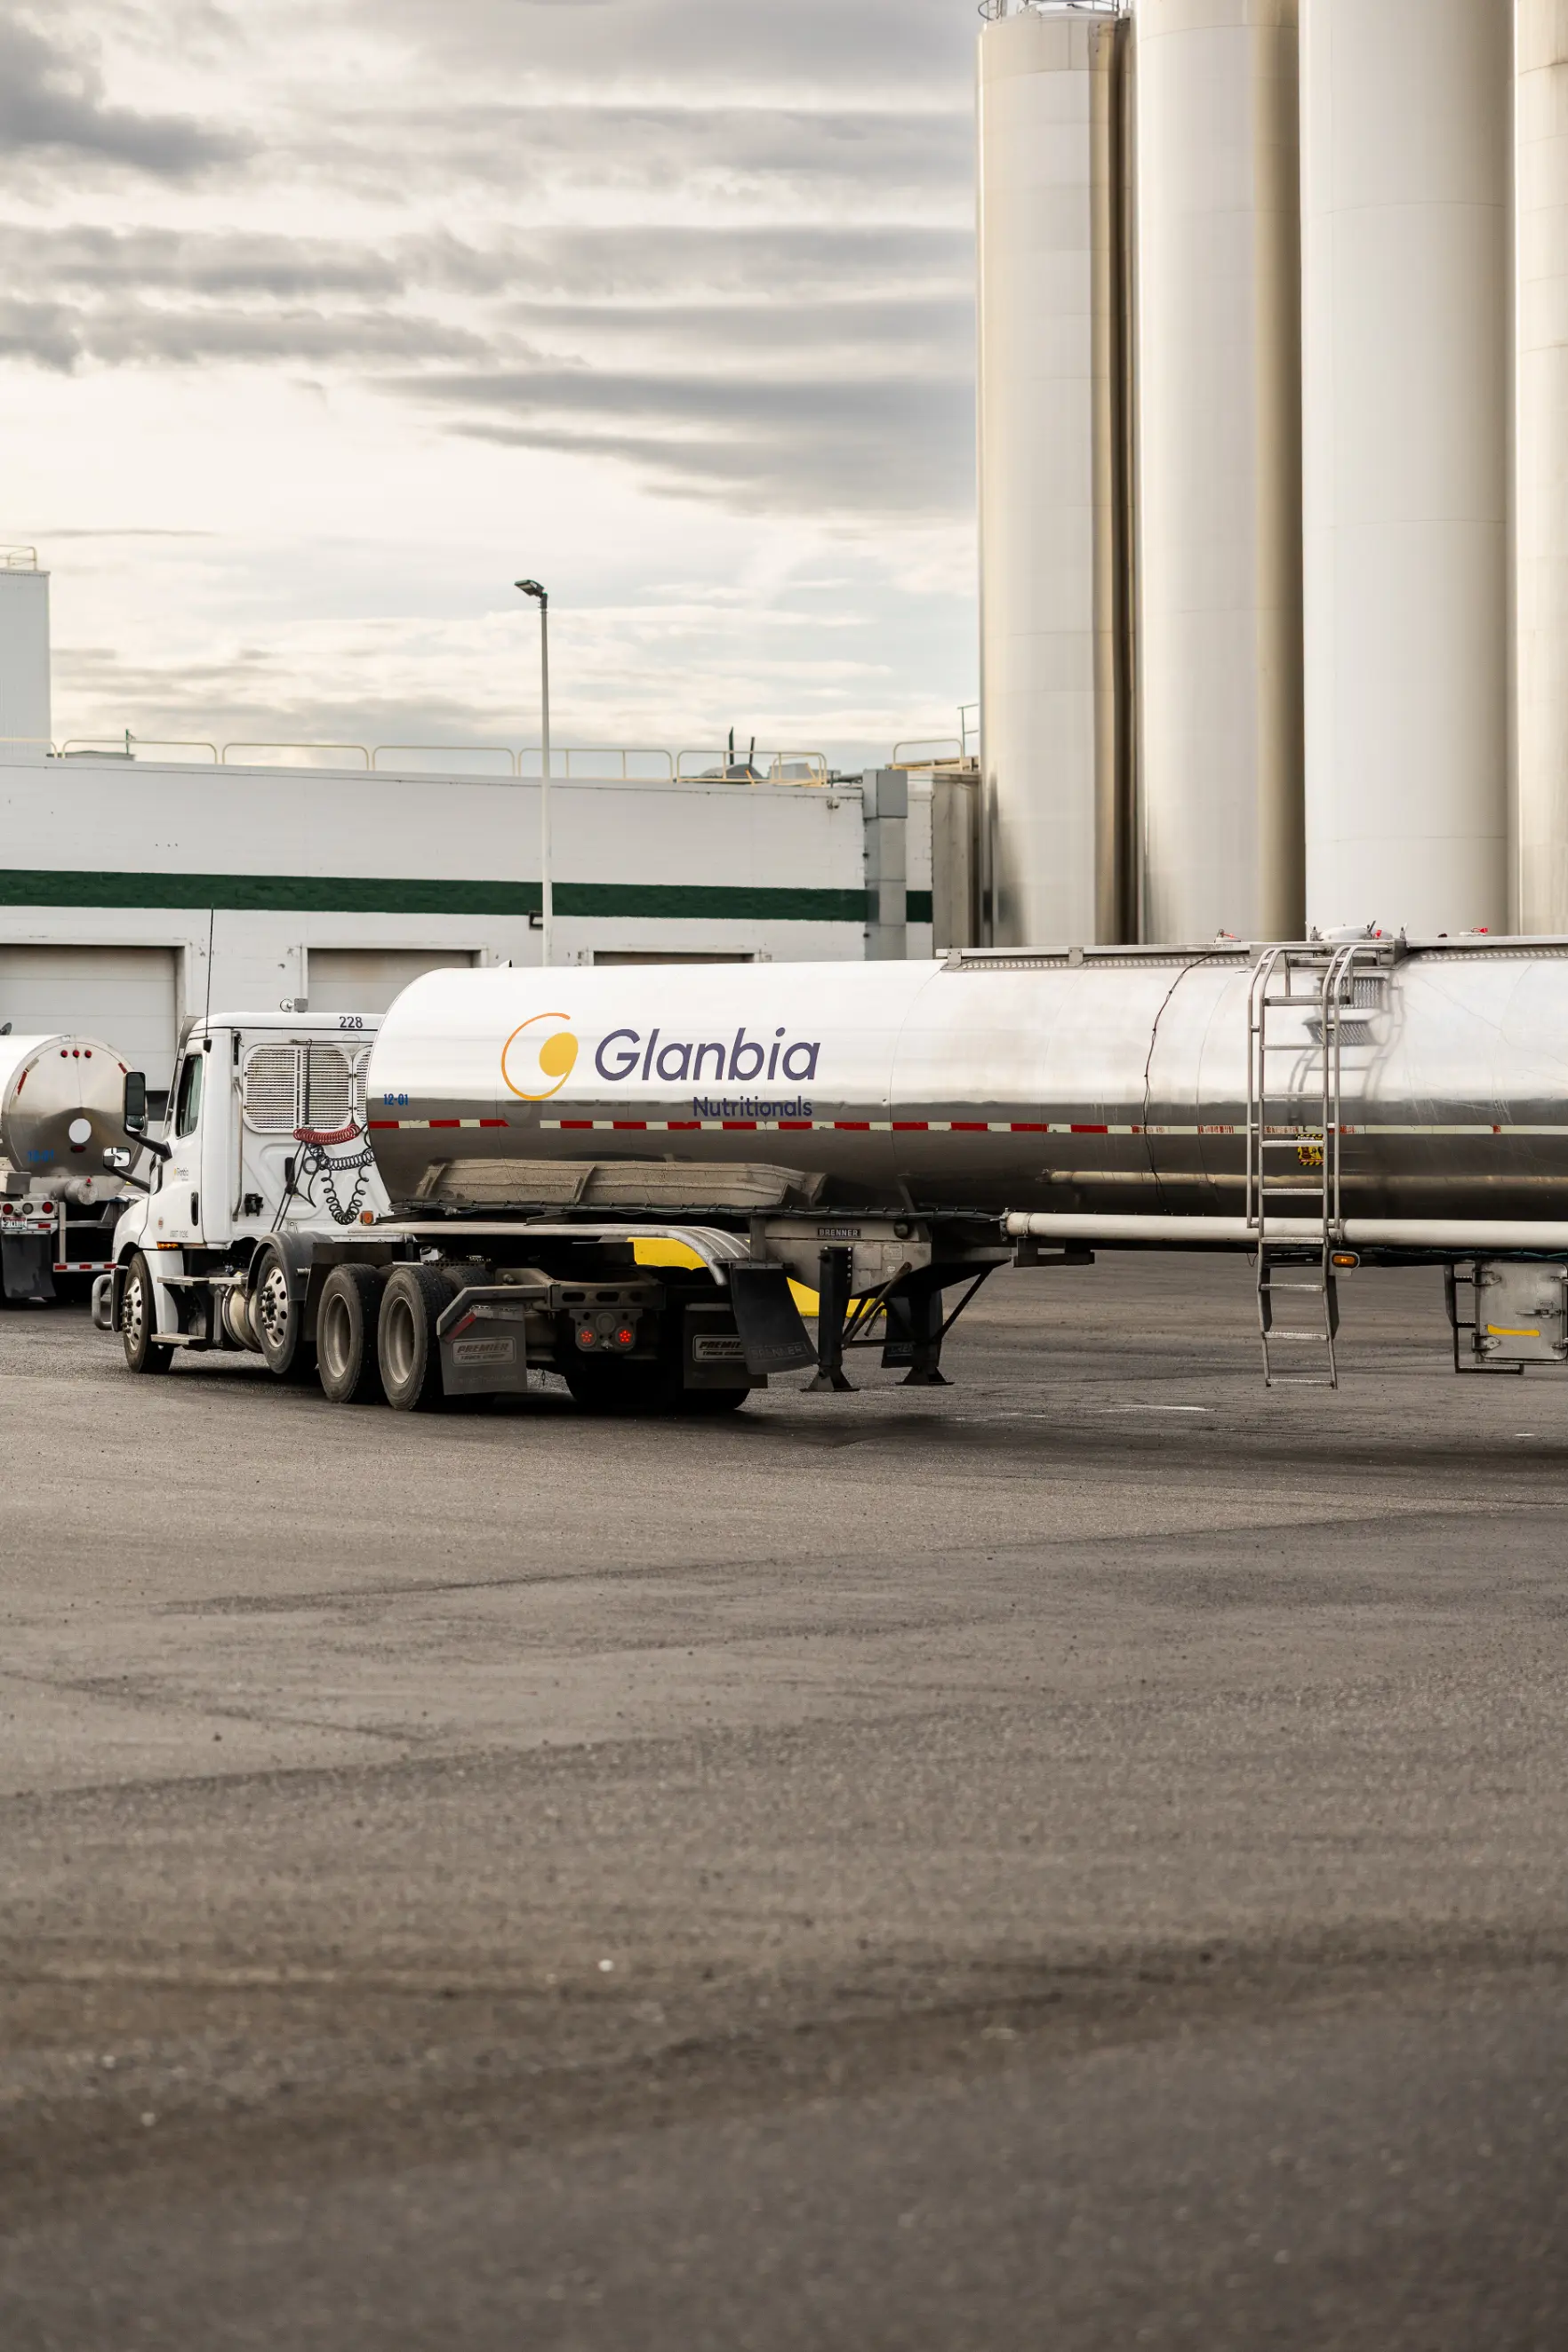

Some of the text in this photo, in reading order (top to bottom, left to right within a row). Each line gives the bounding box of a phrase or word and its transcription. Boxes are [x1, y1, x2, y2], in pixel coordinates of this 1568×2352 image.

[339, 1016, 364, 1028] 228
[595, 1027, 821, 1081] Glanbia
[383, 1093, 409, 1106] 12-01
[692, 1096, 813, 1117] Nutritionals
[819, 1228, 859, 1236] BRENNER
[457, 1343, 509, 1353] PREMIER
